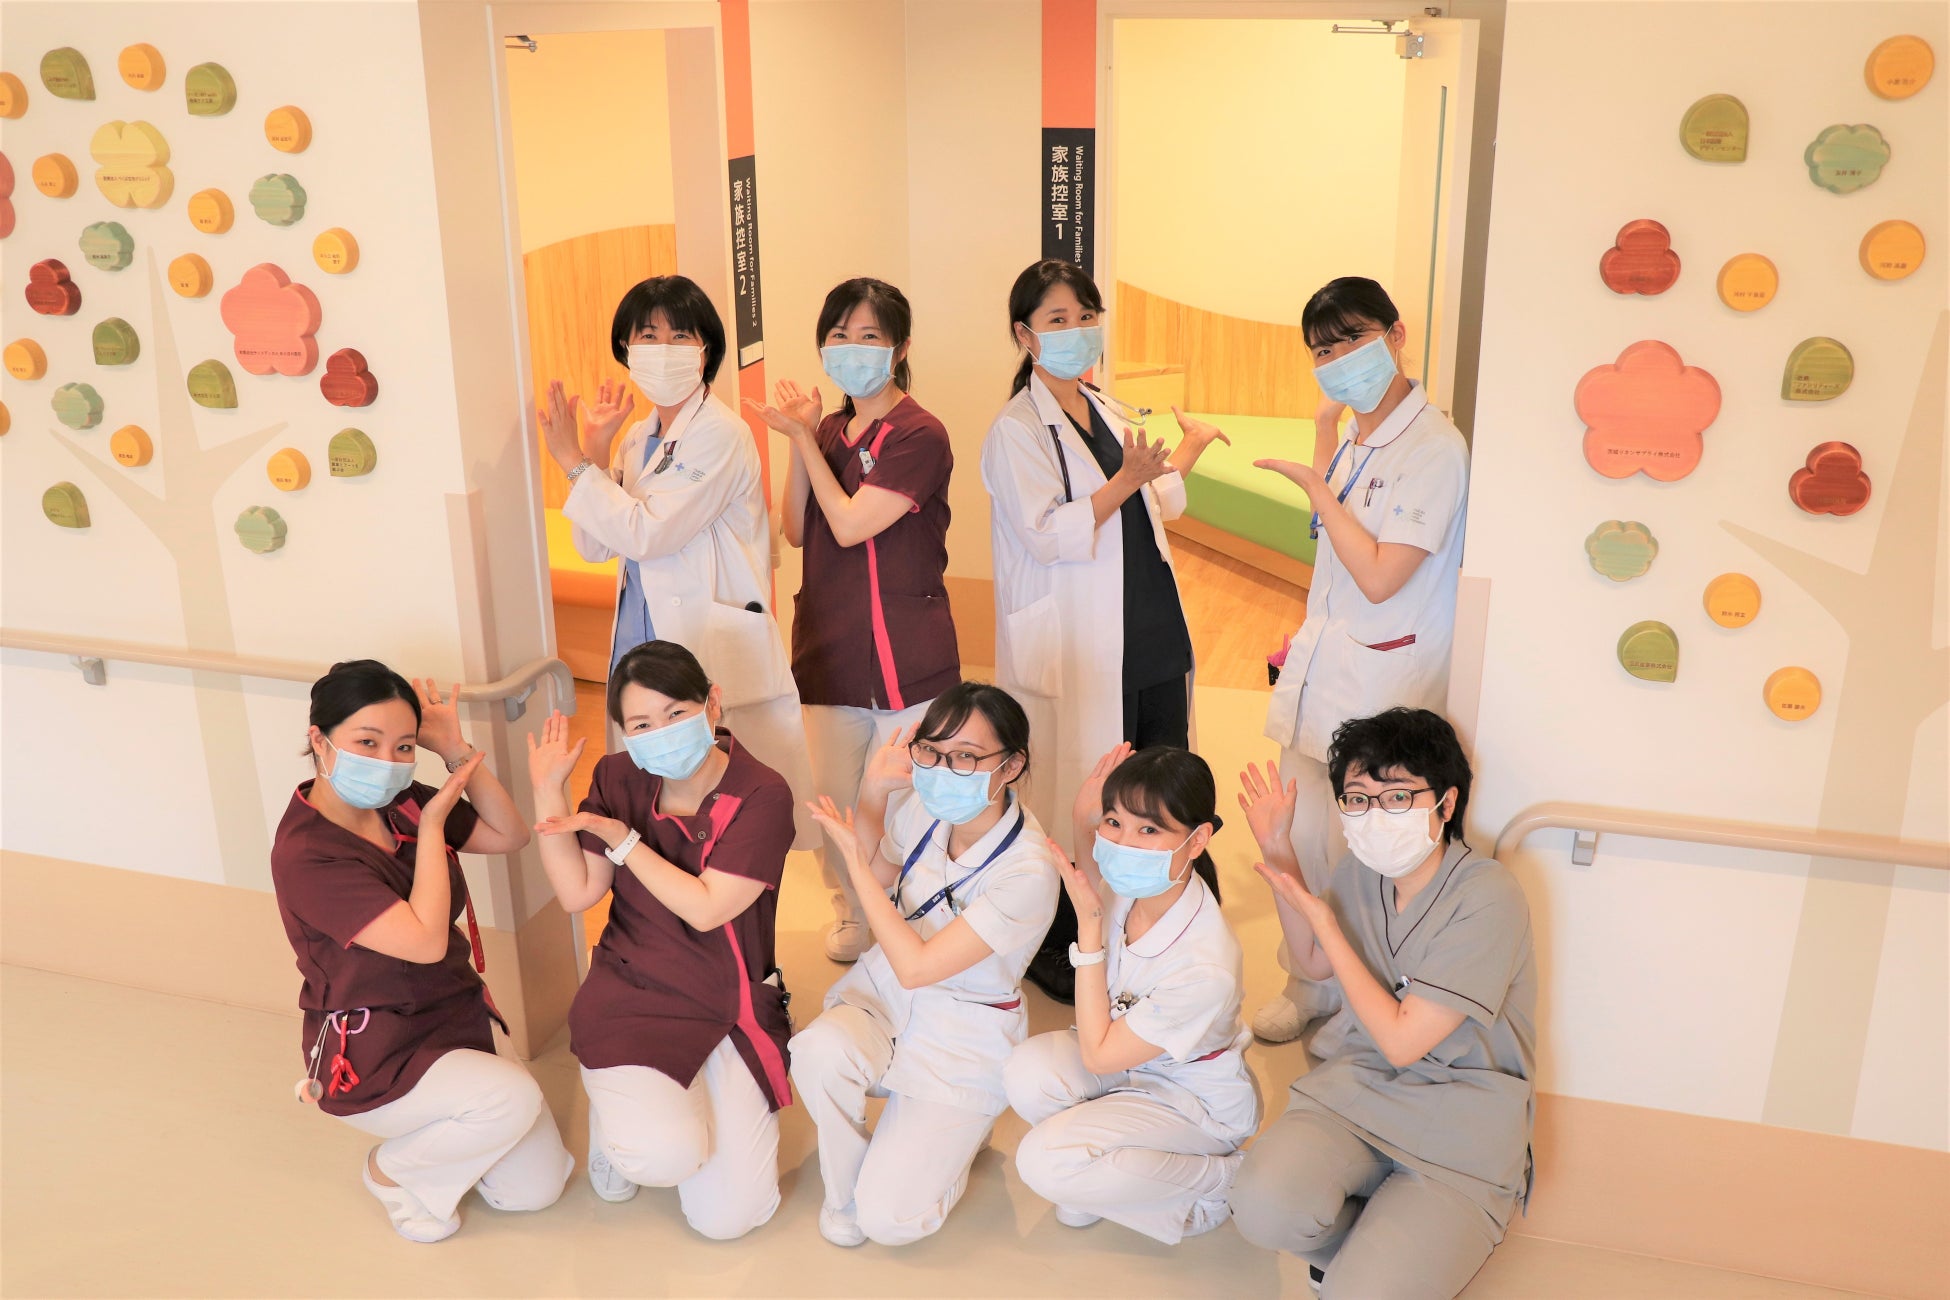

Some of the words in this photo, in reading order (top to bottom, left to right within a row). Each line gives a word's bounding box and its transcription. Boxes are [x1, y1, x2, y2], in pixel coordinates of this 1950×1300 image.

[1074, 146, 1084, 181] Waiting
[1051, 146, 1068, 240] 家族控室1
[1075, 183, 1084, 210] Room
[1075, 211, 1084, 225] for
[734, 180, 747, 295] 家族控室2
[1074, 226, 1083, 263] Families
